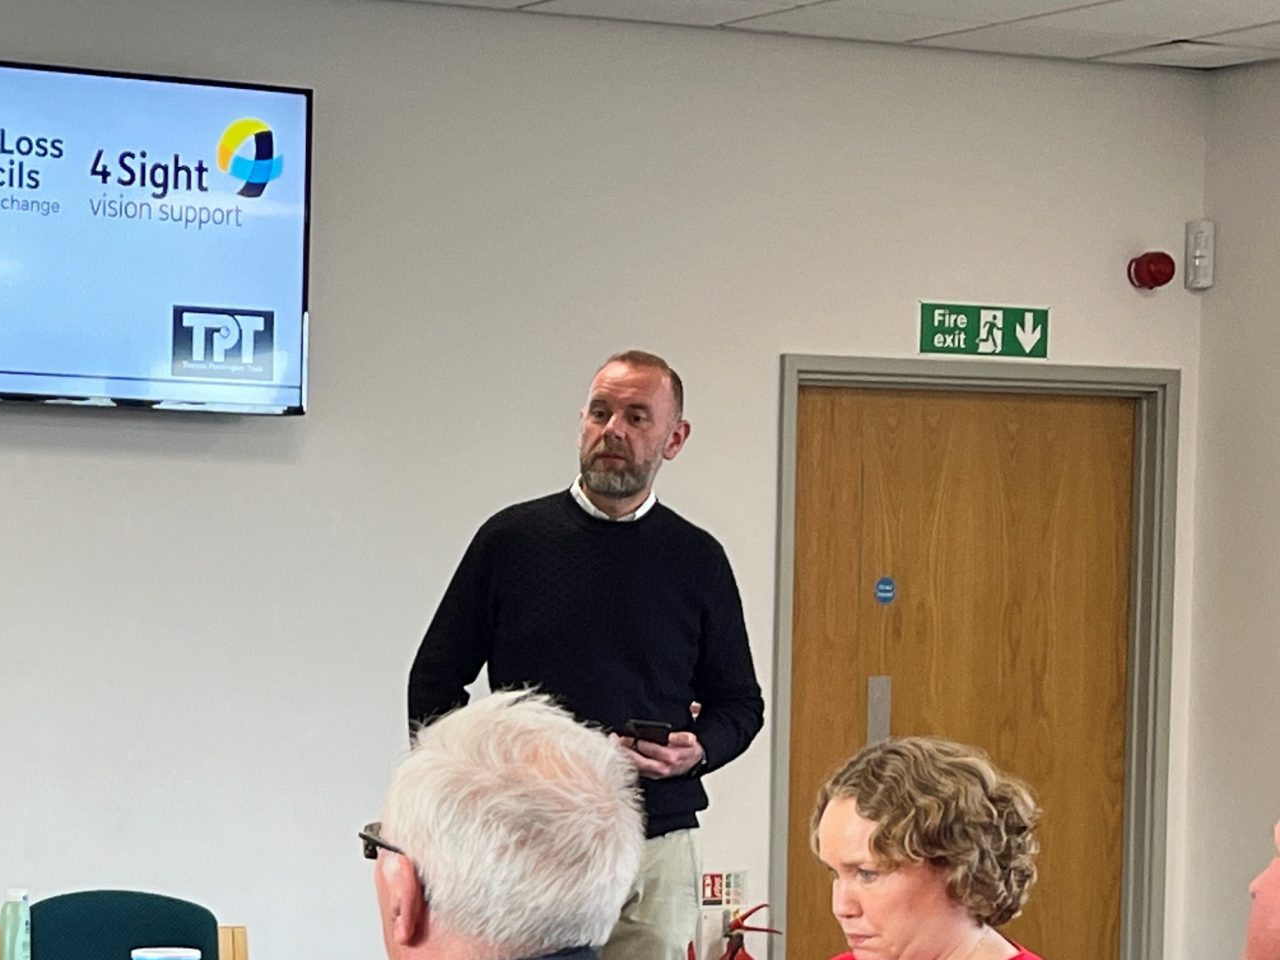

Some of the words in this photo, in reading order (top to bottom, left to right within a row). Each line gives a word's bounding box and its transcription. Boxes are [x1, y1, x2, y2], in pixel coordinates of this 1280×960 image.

[0, 128, 64, 159] Loss
[0, 194, 61, 216] change
[89, 192, 152, 221] vision
[158, 202, 243, 230] support
[933, 308, 968, 328] Fire
[182, 312, 265, 364] TPT
[933, 329, 966, 348] exit
